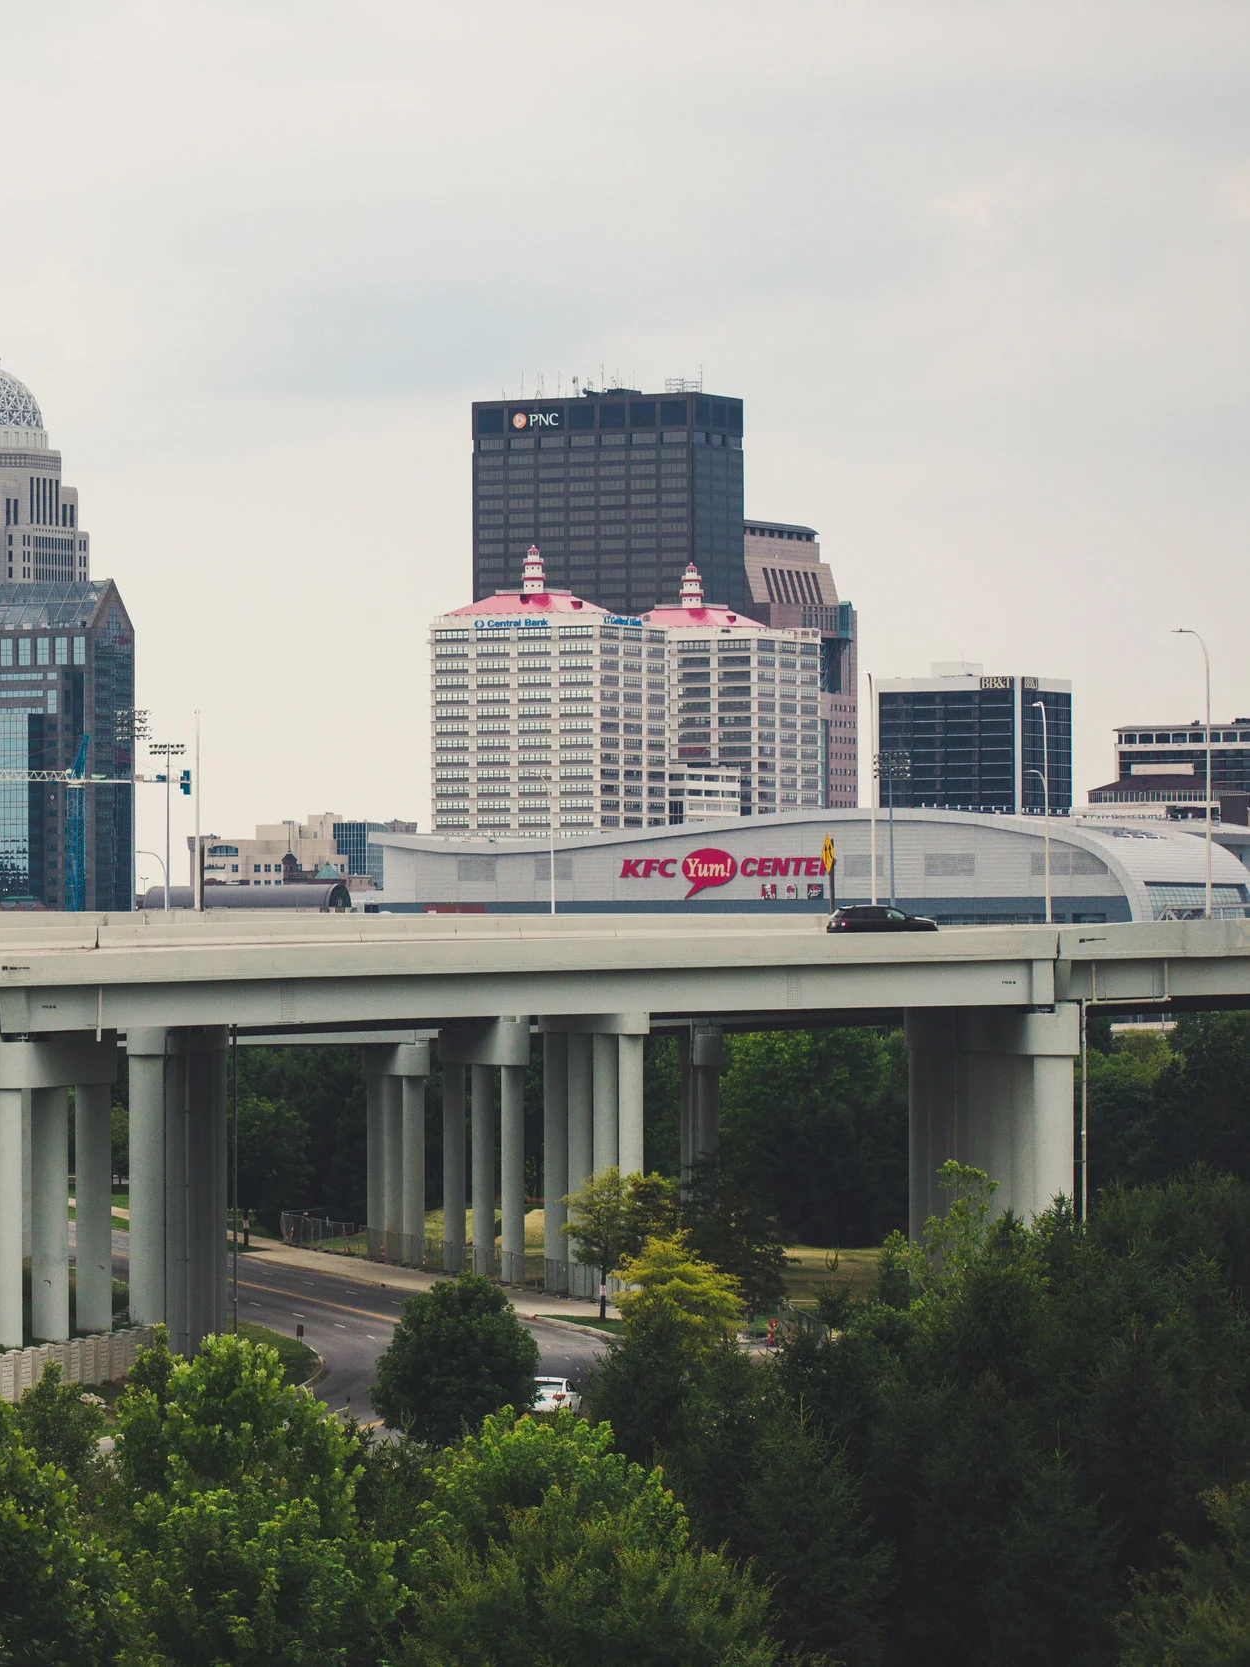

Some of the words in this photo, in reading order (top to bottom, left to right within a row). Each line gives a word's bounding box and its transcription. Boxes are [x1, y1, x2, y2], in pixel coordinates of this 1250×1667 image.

[528, 413, 559, 427] PNC
[487, 618, 522, 628] Central
[524, 618, 548, 627] Bank
[981, 677, 1013, 689] BB&T
[619, 858, 678, 879] KFC
[685, 857, 732, 878] Yum!
